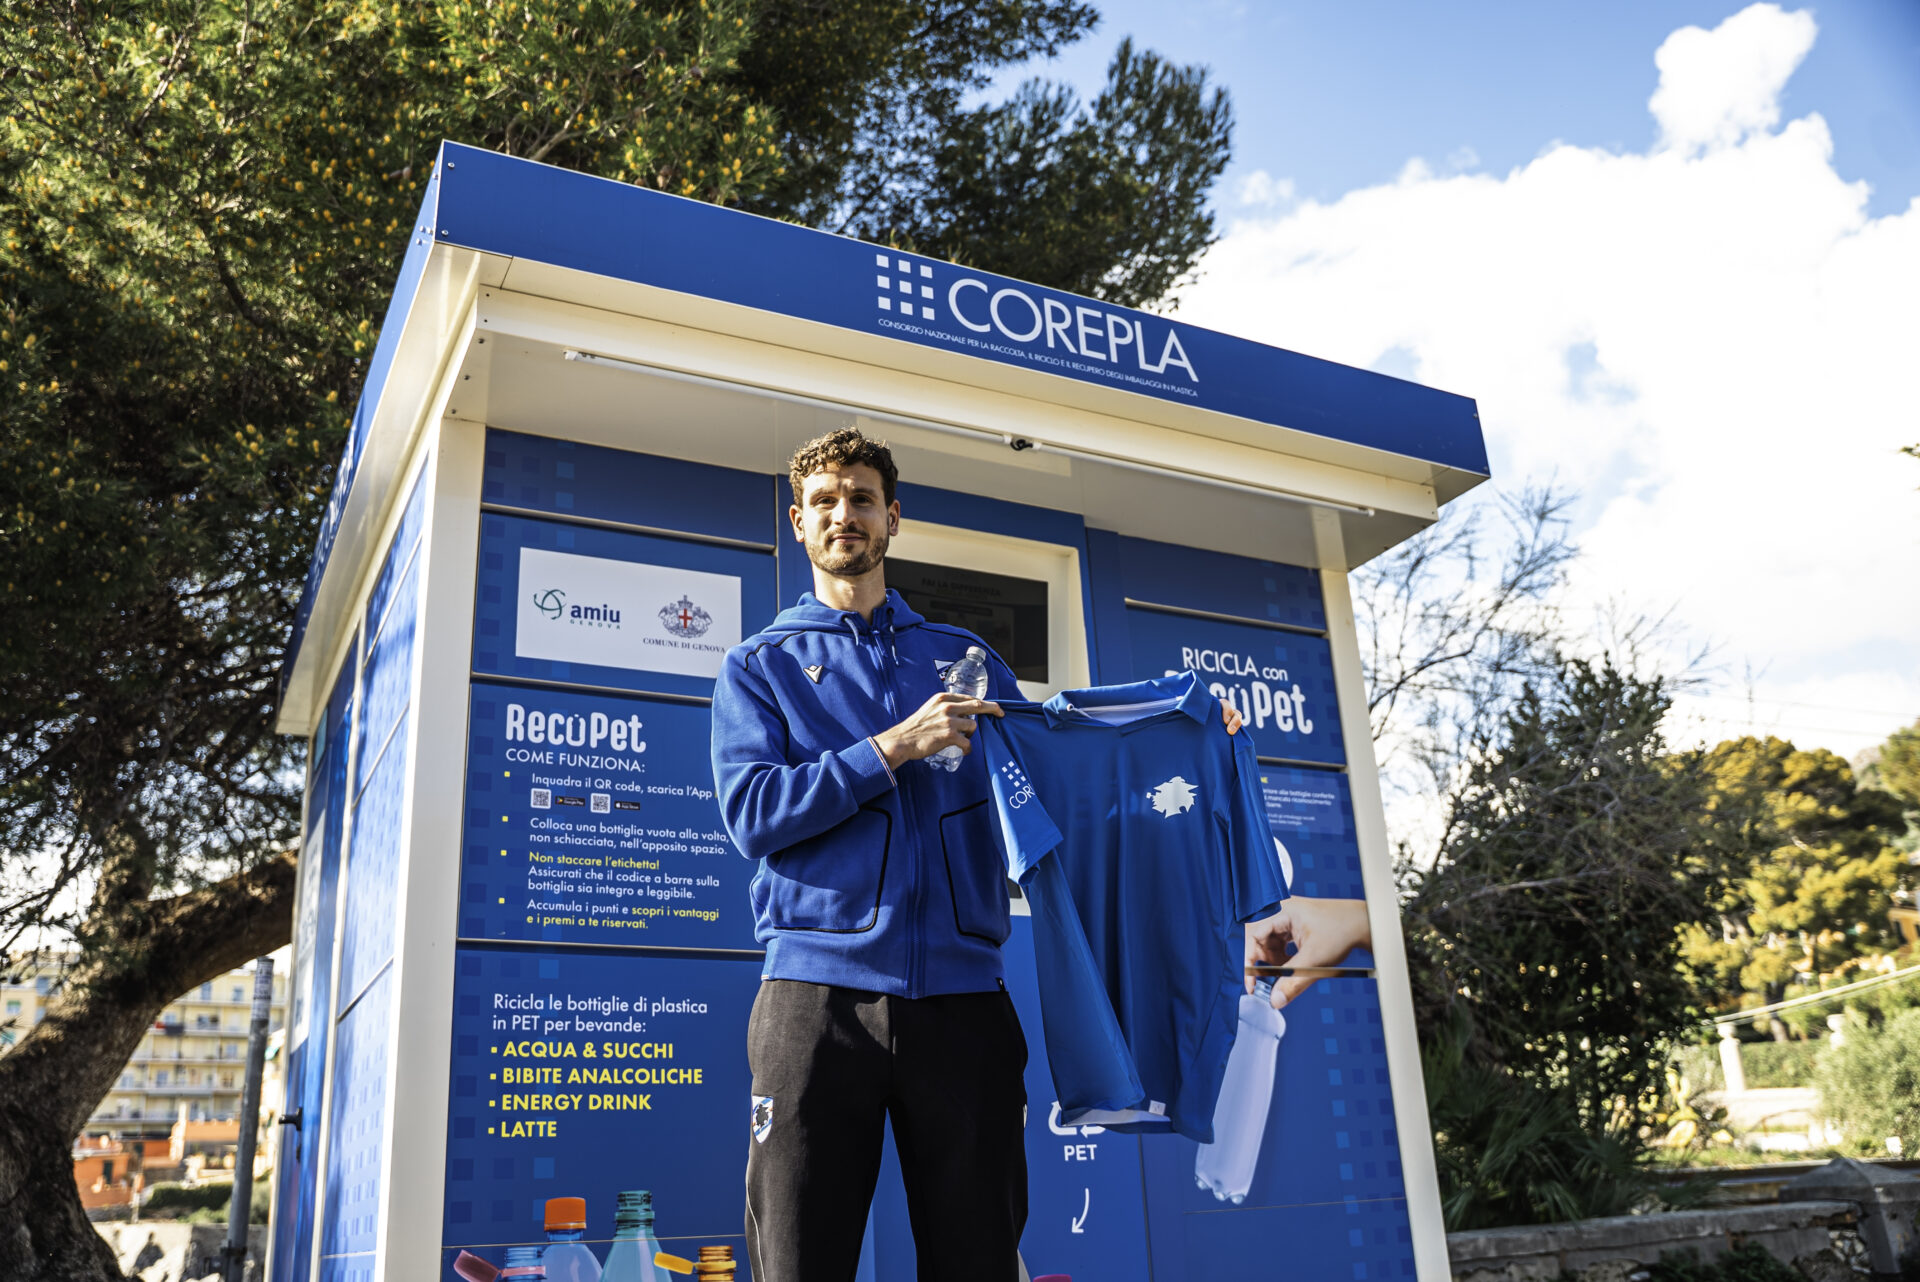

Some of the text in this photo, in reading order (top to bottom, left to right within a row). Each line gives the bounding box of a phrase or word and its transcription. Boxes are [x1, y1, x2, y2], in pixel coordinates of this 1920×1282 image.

[949, 278, 1199, 382] COREPLA
[878, 318, 1198, 398] CONSORZIO NAZIONALE PER LA RACCOLTA, IL RICICLO E IL RECUPERO DEGLI IMBALLAGGI IN PLASTICA
[570, 604, 621, 623] amiu
[643, 637, 726, 654] COMUNE DI GENOVA
[1182, 647, 1288, 681] RICICLA con
[506, 748, 645, 773] COME FUNZIONA:
[532, 774, 582, 789] Inquadra
[585, 777, 591, 788] il
[595, 778, 612, 790] QR
[615, 782, 644, 794] code,
[647, 785, 684, 796] scarica
[687, 786, 712, 799] l'App
[1010, 783, 1035, 809] COR
[530, 818, 730, 843] Colloca una bottiglia vuota alla volta,
[530, 834, 727, 856] non schiacciata, nell'apposito spazio.
[529, 852, 660, 870] Non staccare l'etichetta!
[528, 866, 720, 887] Assicurati che il codice a barre sulla
[528, 880, 696, 900] bottiglia sia integro e leggibile.
[527, 900, 719, 921] Accumula i punti e scopri i vantaggi
[527, 914, 649, 929] e i premi a te riservati.
[494, 994, 708, 1017] Ricicla le bottiglie di plastica
[493, 1015, 646, 1035] in PET per bevande:
[503, 1041, 673, 1059] ACQUA & SUCCHI
[503, 1068, 703, 1084] BIBITE ANALCOLICHE
[502, 1094, 652, 1111] ENERGY DRINK
[501, 1121, 557, 1138] LATTE
[1064, 1144, 1097, 1161] PET
